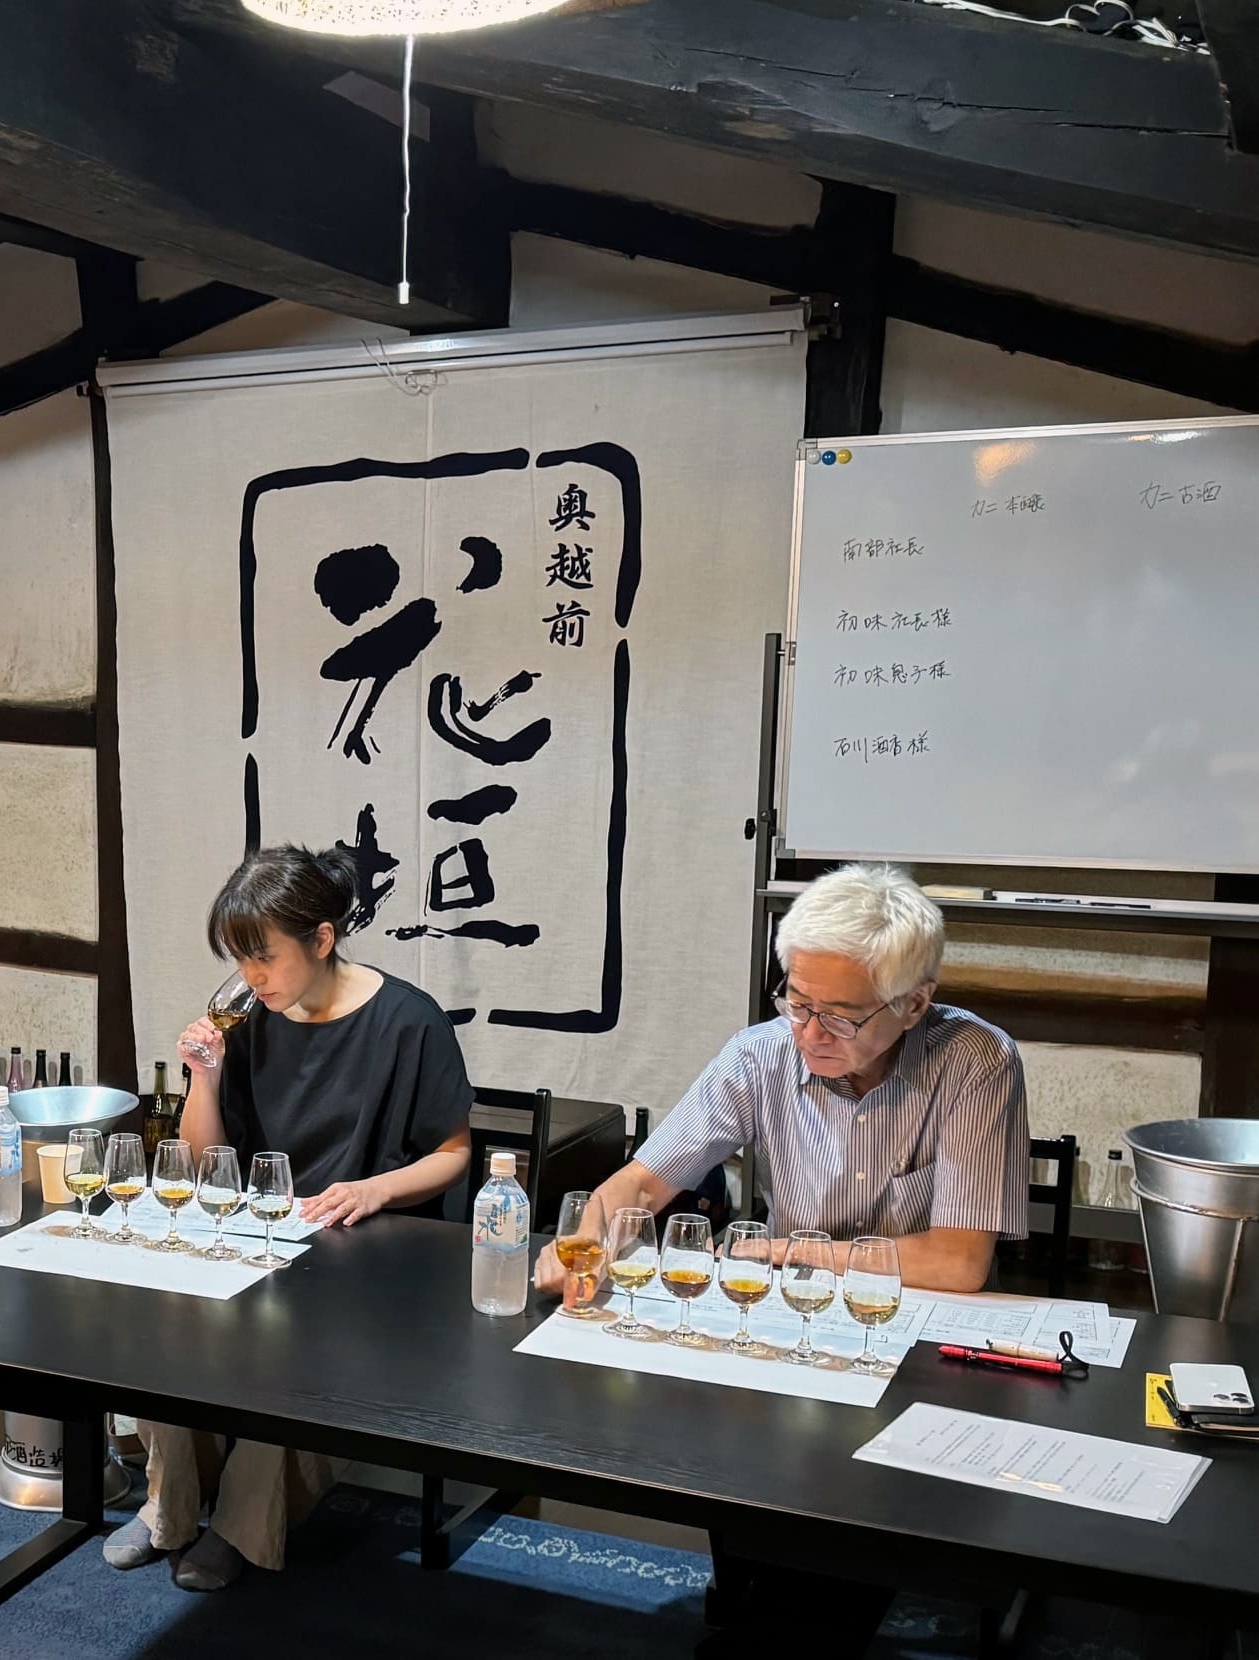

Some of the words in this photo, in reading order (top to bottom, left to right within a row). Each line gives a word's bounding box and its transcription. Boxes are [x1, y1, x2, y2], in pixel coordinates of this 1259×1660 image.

[542, 483, 596, 648] 奥越前
[843, 536, 925, 563] 南部社長
[314, 536, 551, 948] 花垣
